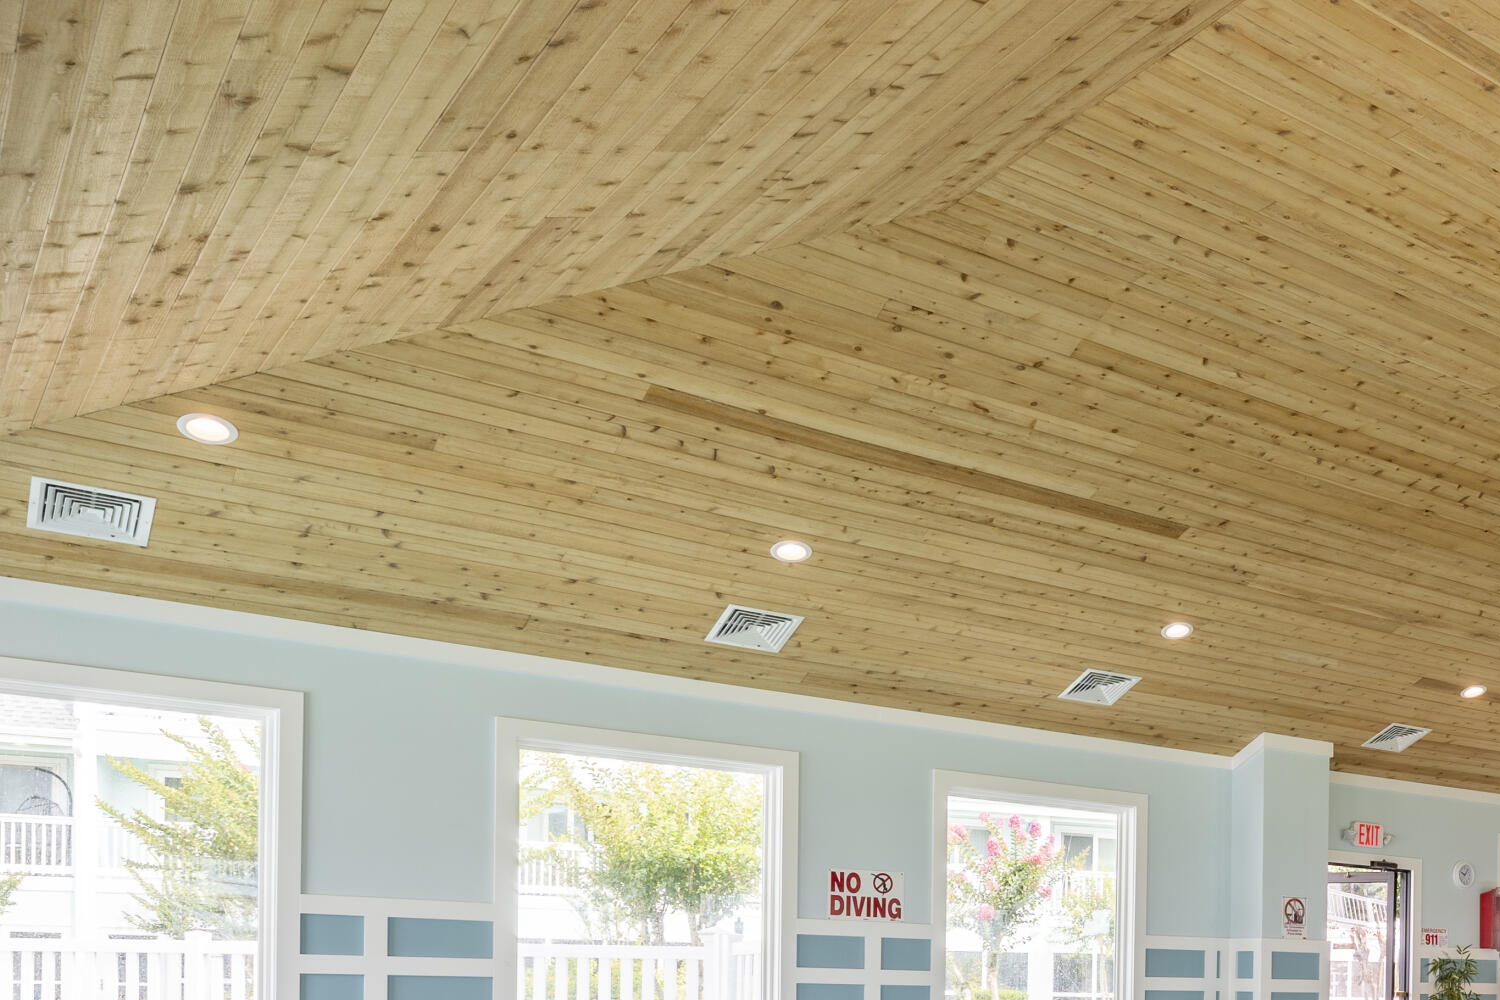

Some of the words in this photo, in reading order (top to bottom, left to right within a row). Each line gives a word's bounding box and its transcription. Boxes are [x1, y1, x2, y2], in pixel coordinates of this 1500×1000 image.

[1358, 823, 1380, 846] EXIT
[830, 871, 861, 893] NO
[830, 894, 902, 919] DIVING
[1425, 933, 1438, 945] 911
